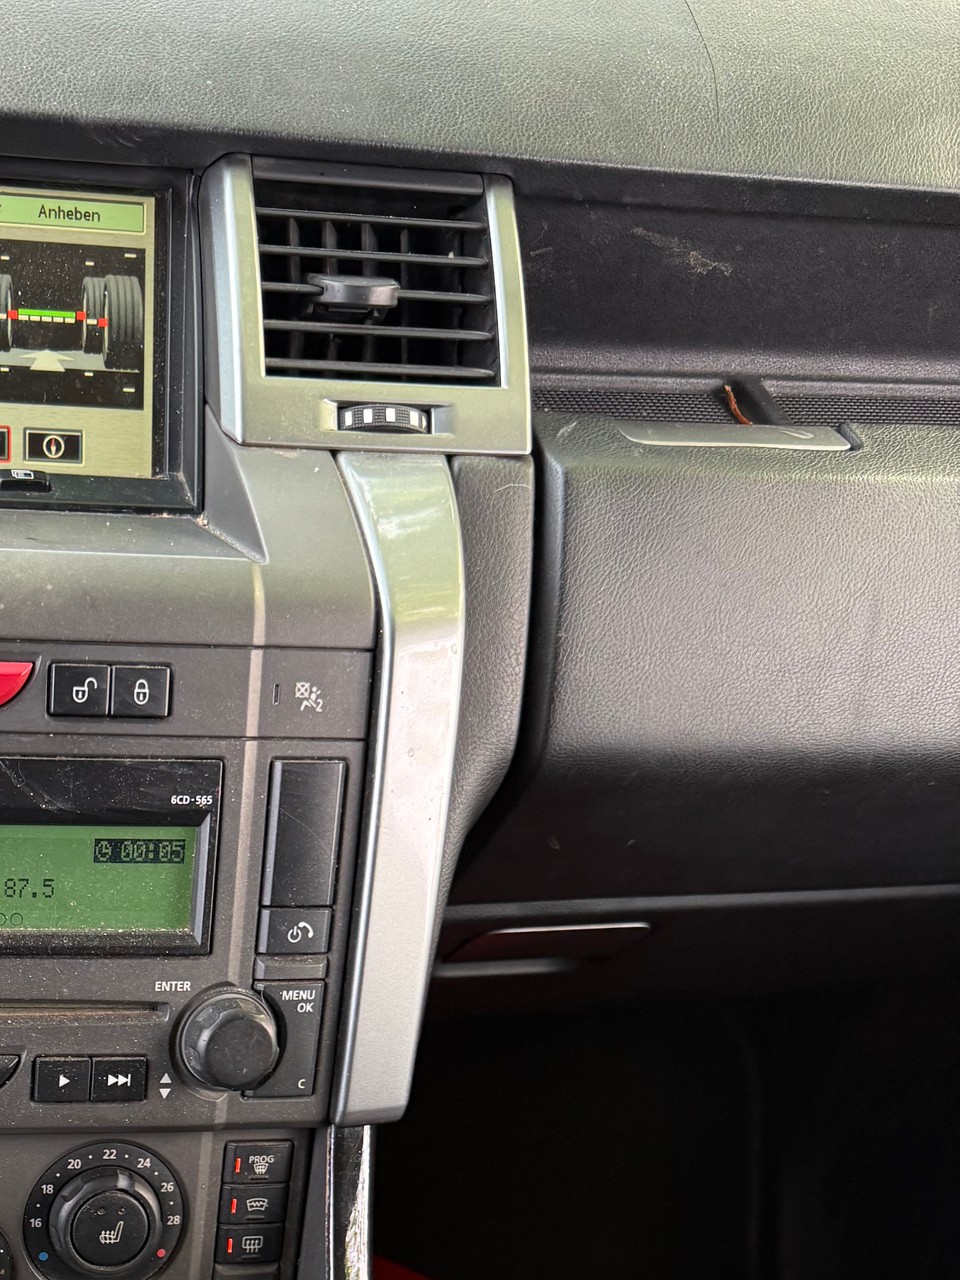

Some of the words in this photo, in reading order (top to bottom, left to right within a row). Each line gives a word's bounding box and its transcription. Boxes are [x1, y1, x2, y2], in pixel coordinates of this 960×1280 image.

[38, 204, 101, 223] Anheben
[121, 840, 186, 861] 00:05
[4, 878, 55, 898] 87.5
[154, 981, 191, 992] ENTER
[282, 989, 316, 1001] MENU
[297, 1003, 314, 1013] OK
[298, 1079, 305, 1089] C
[102, 1149, 117, 1160] 22
[248, 1155, 275, 1164] PROG
[67, 1159, 82, 1170] 20
[137, 1158, 152, 1169] 24
[41, 1184, 54, 1195] 18
[160, 1182, 174, 1193] 26
[29, 1218, 42, 1229] 16
[167, 1215, 181, 1226] 28
